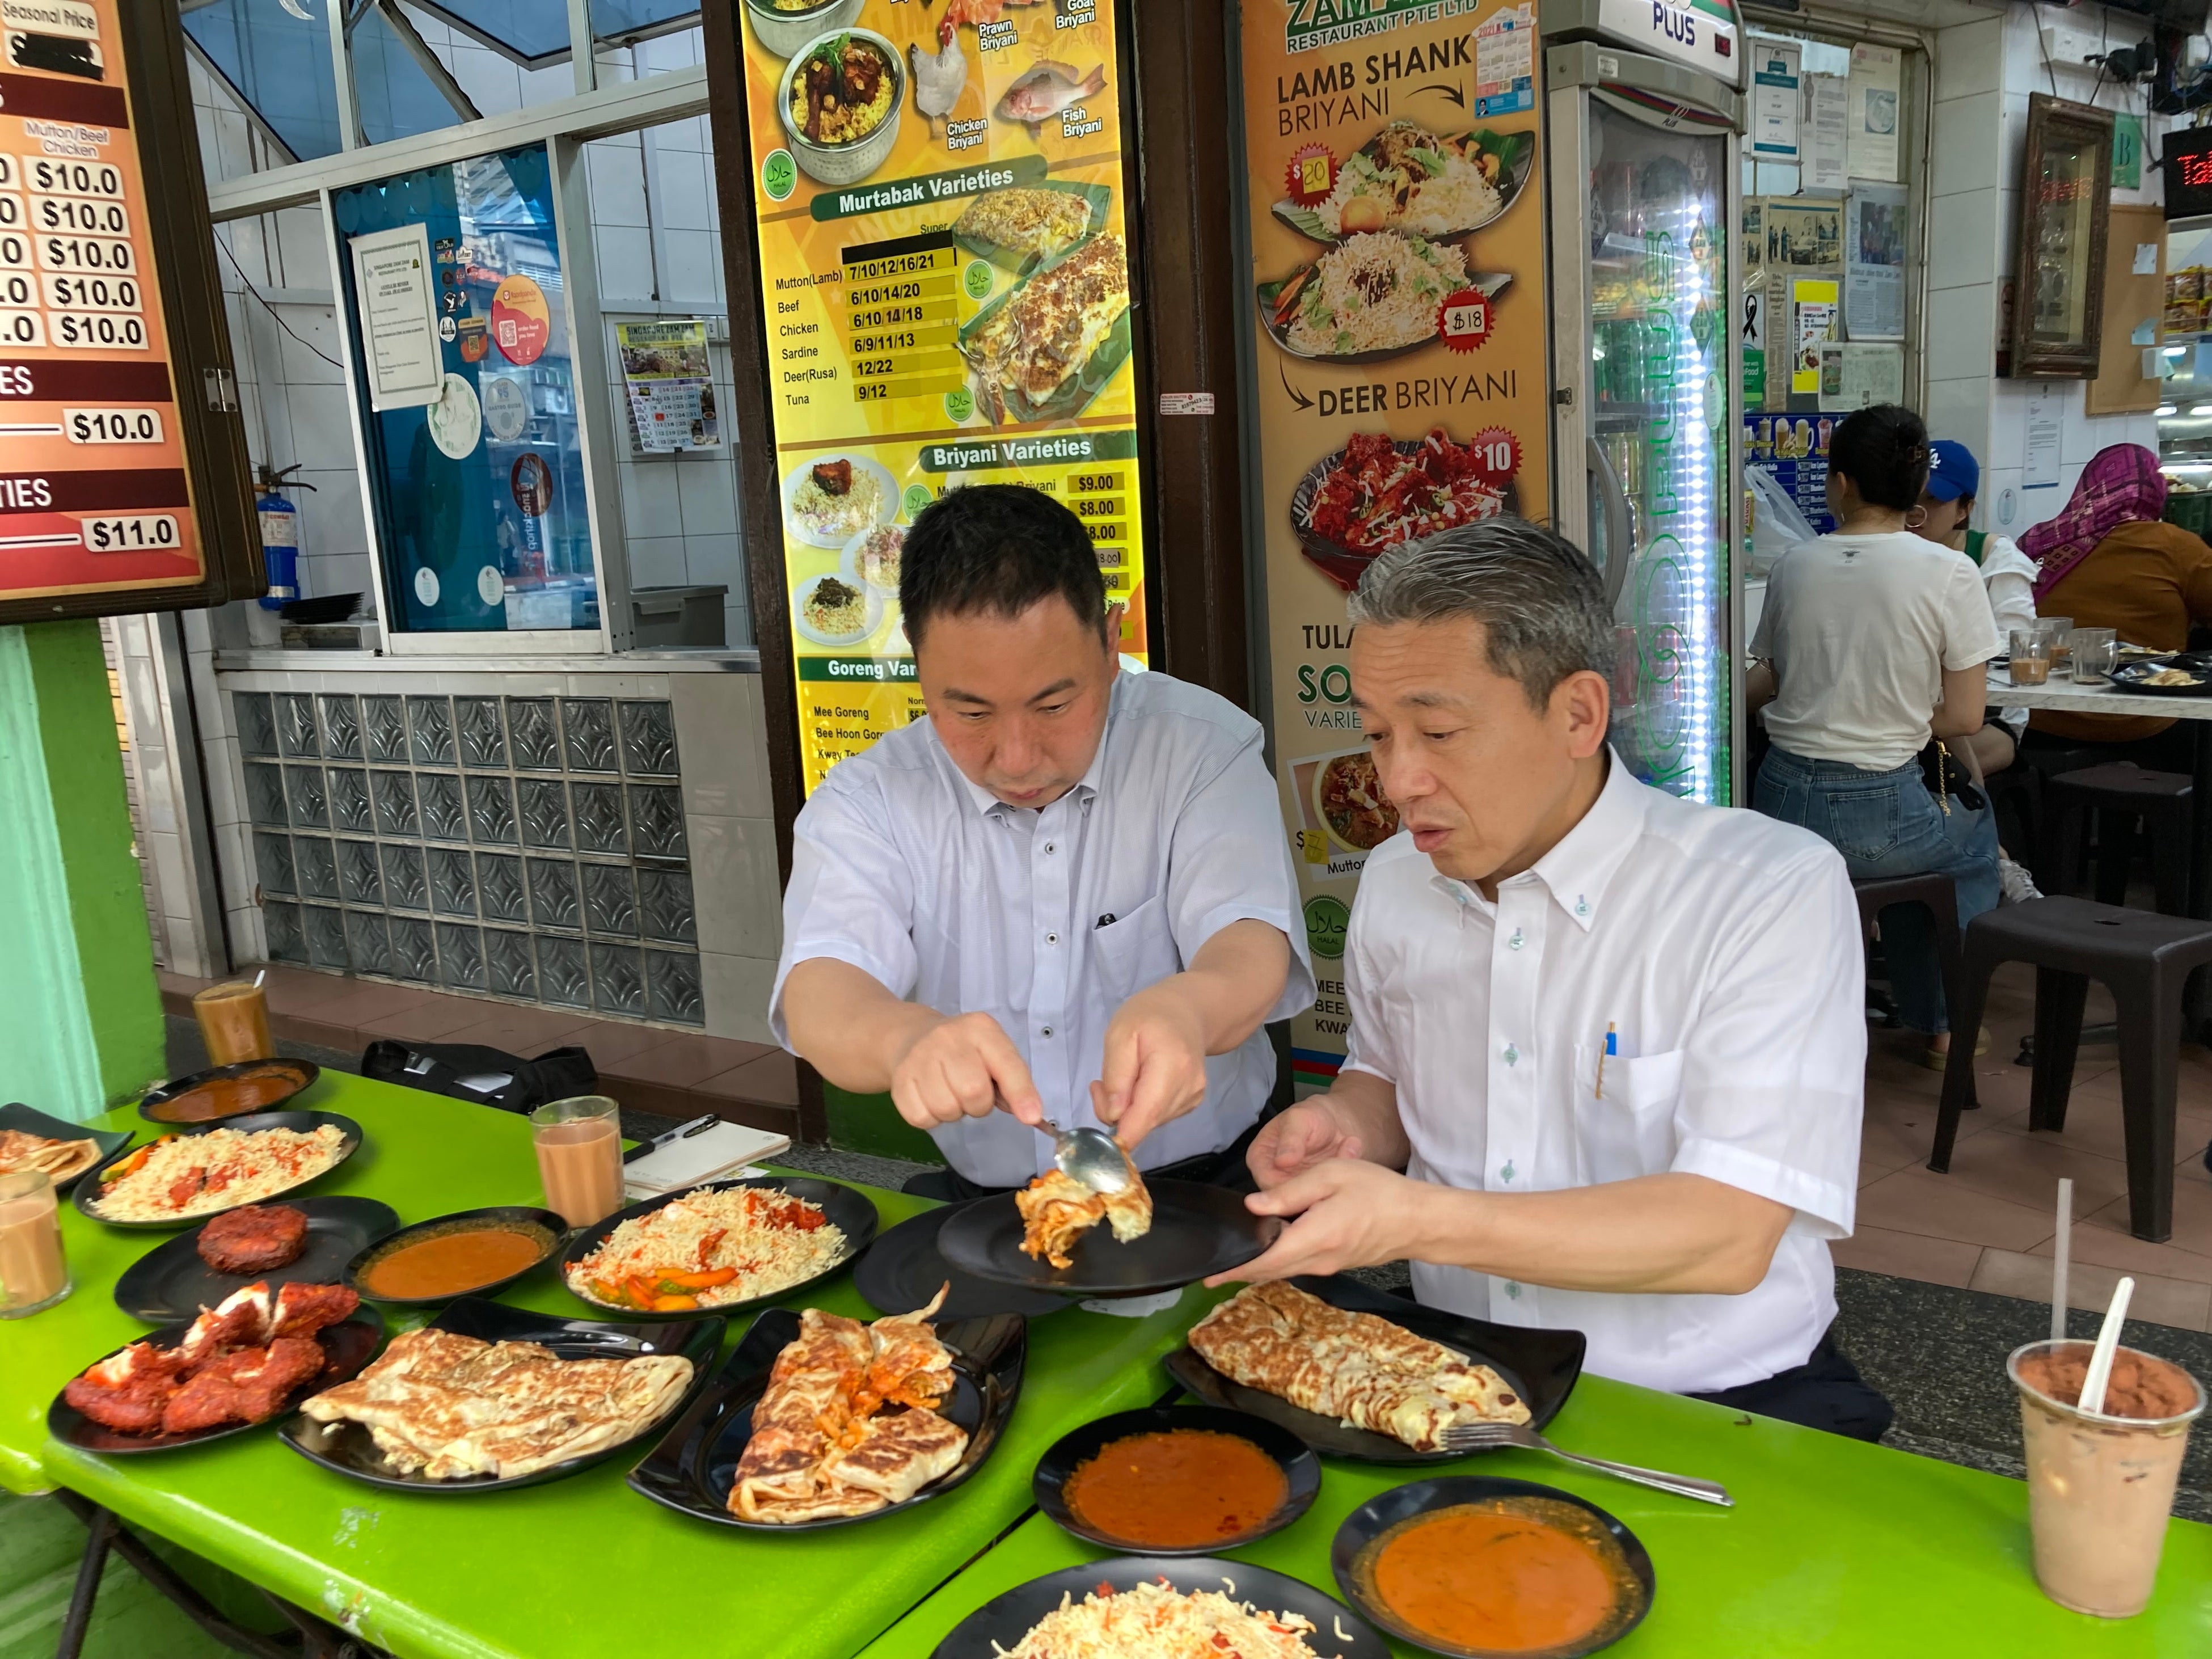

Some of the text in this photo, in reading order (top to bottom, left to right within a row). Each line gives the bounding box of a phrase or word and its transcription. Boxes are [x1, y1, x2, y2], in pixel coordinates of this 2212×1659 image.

[2, 1, 95, 29] Seasonal Price
[1056, 9, 1096, 29] Briyani
[1654, 1, 1695, 46] PLUS
[979, 20, 1013, 37] Prawn
[1287, 14, 1398, 52] RESTAURANT
[1405, 5, 1439, 25] PTE
[980, 32, 1018, 52] Briyani
[1278, 34, 1472, 103] LAMB SHANK
[1062, 108, 1087, 124] Fish
[1280, 87, 1389, 136] BRIYANI
[26, 121, 108, 142] Mutton/Beef
[947, 117, 987, 136] Chicken
[1062, 119, 1102, 138] Briyani
[44, 141, 98, 158] Chicken
[948, 133, 983, 151] Briyani
[2120, 132, 2131, 166] B
[37, 160, 117, 194] $10.0
[767, 164, 791, 182] حلال
[839, 167, 1014, 214] Murtabak Varieties
[44, 199, 124, 232] $10.0
[920, 223, 948, 234] Super
[49, 237, 129, 268] $10.0
[776, 254, 935, 290] Mutton(Lamb) 7/10/12/16/21
[968, 271, 989, 286] حلال
[56, 276, 136, 307] $10.0
[778, 282, 921, 314] Beef 6/10/14/20
[61, 314, 141, 345] $10.0
[780, 323, 818, 337] Chicken
[1453, 311, 1482, 331] $18
[782, 332, 915, 360] Sardine 6/9/11/13
[784, 359, 893, 383] Deer(Rusa) 12/22
[786, 384, 887, 406] Tuna 9/12
[1319, 369, 1517, 416] DEER BRIYANI
[74, 412, 154, 443] $10.0
[934, 440, 1091, 467] Briyani Varieties
[1475, 442, 1512, 471] $10
[1079, 475, 1113, 492] $9.00
[1079, 500, 1114, 516] $8.00
[94, 520, 171, 549] $11.0
[1089, 525, 1116, 539] 8.00
[828, 660, 884, 679] Goreng
[814, 706, 833, 717] Mee
[835, 707, 869, 720] Goreng
[1305, 711, 1362, 728] VARIE
[816, 728, 833, 738] Bee
[836, 728, 860, 738] Hoon
[818, 749, 842, 761] Kway
[1315, 999, 1345, 1015] BEE
[1316, 1019, 1350, 1035] KWA
